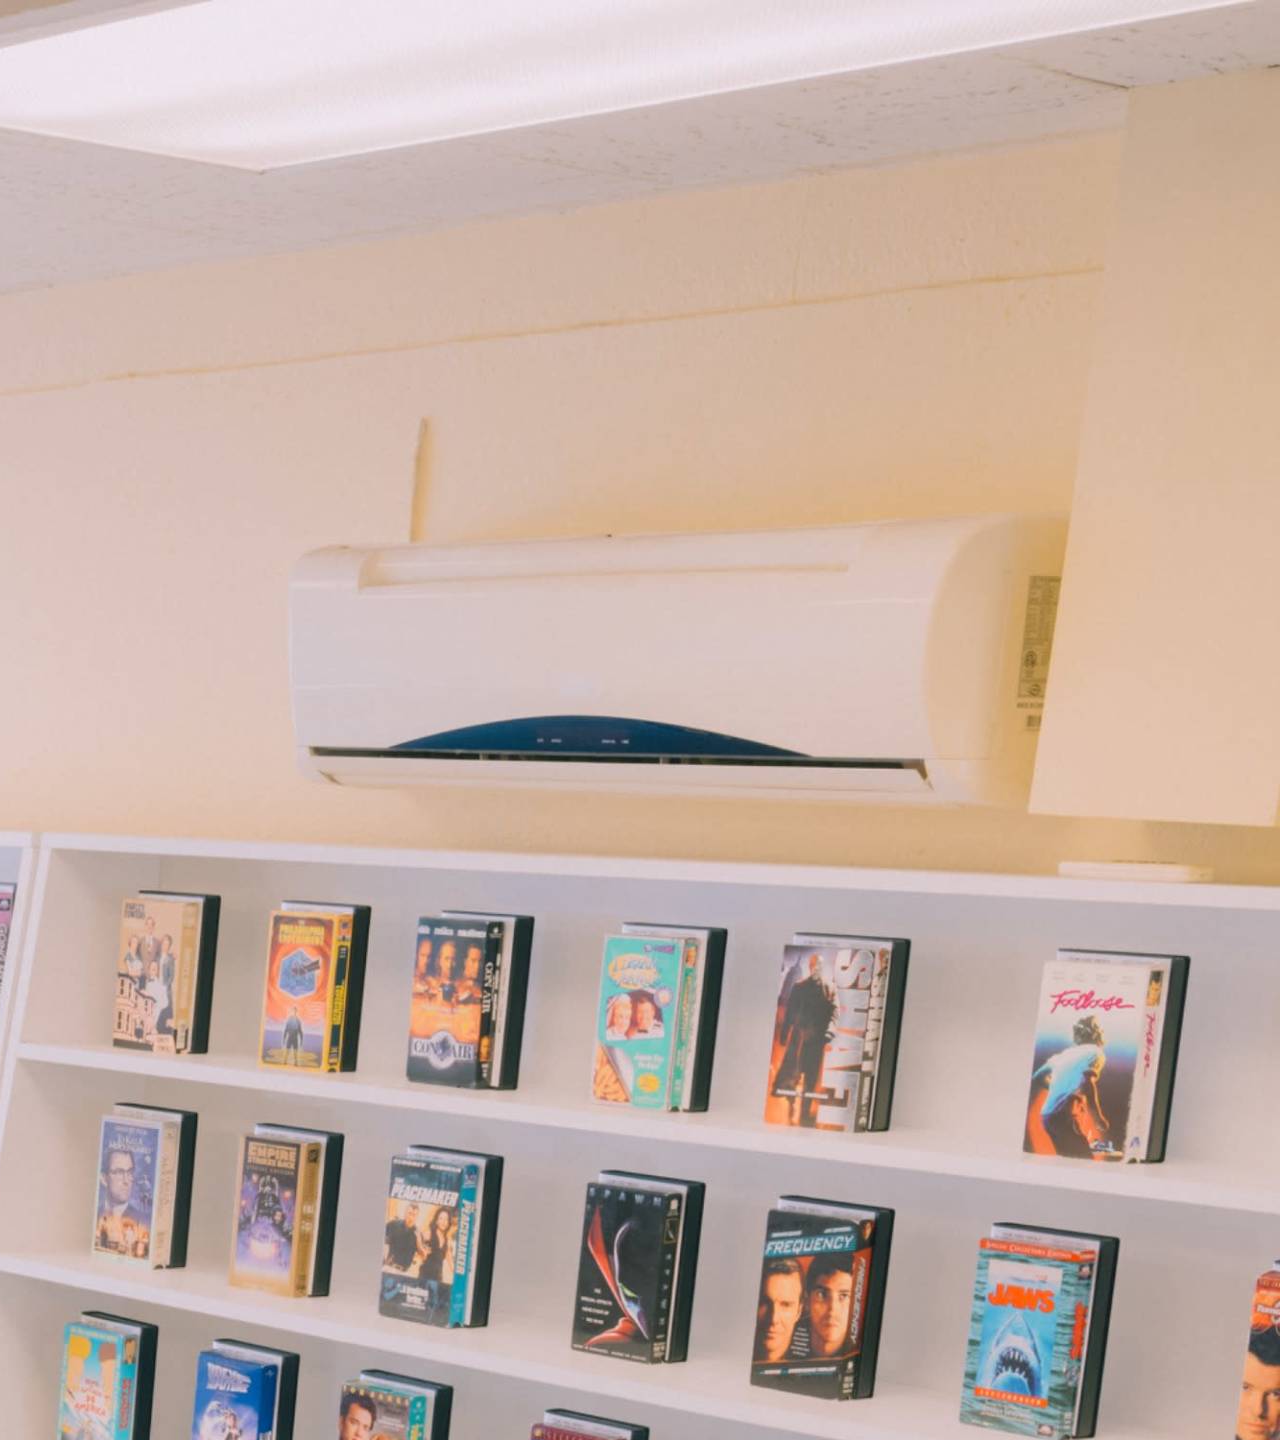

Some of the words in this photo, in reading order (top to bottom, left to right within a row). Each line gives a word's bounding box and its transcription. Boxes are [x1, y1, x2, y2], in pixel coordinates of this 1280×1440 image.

[452, 1044, 476, 1062] AIR
[820, 948, 874, 1131] SHAFT
[249, 1143, 298, 1161] EMPIRE
[392, 1182, 460, 1208] PEACEMAKER
[454, 1199, 471, 1275] PEACEMAKER
[765, 1234, 854, 1256] FREQUENCY
[849, 1256, 868, 1343] FREQUENCY
[987, 1283, 1056, 1314] JAWS
